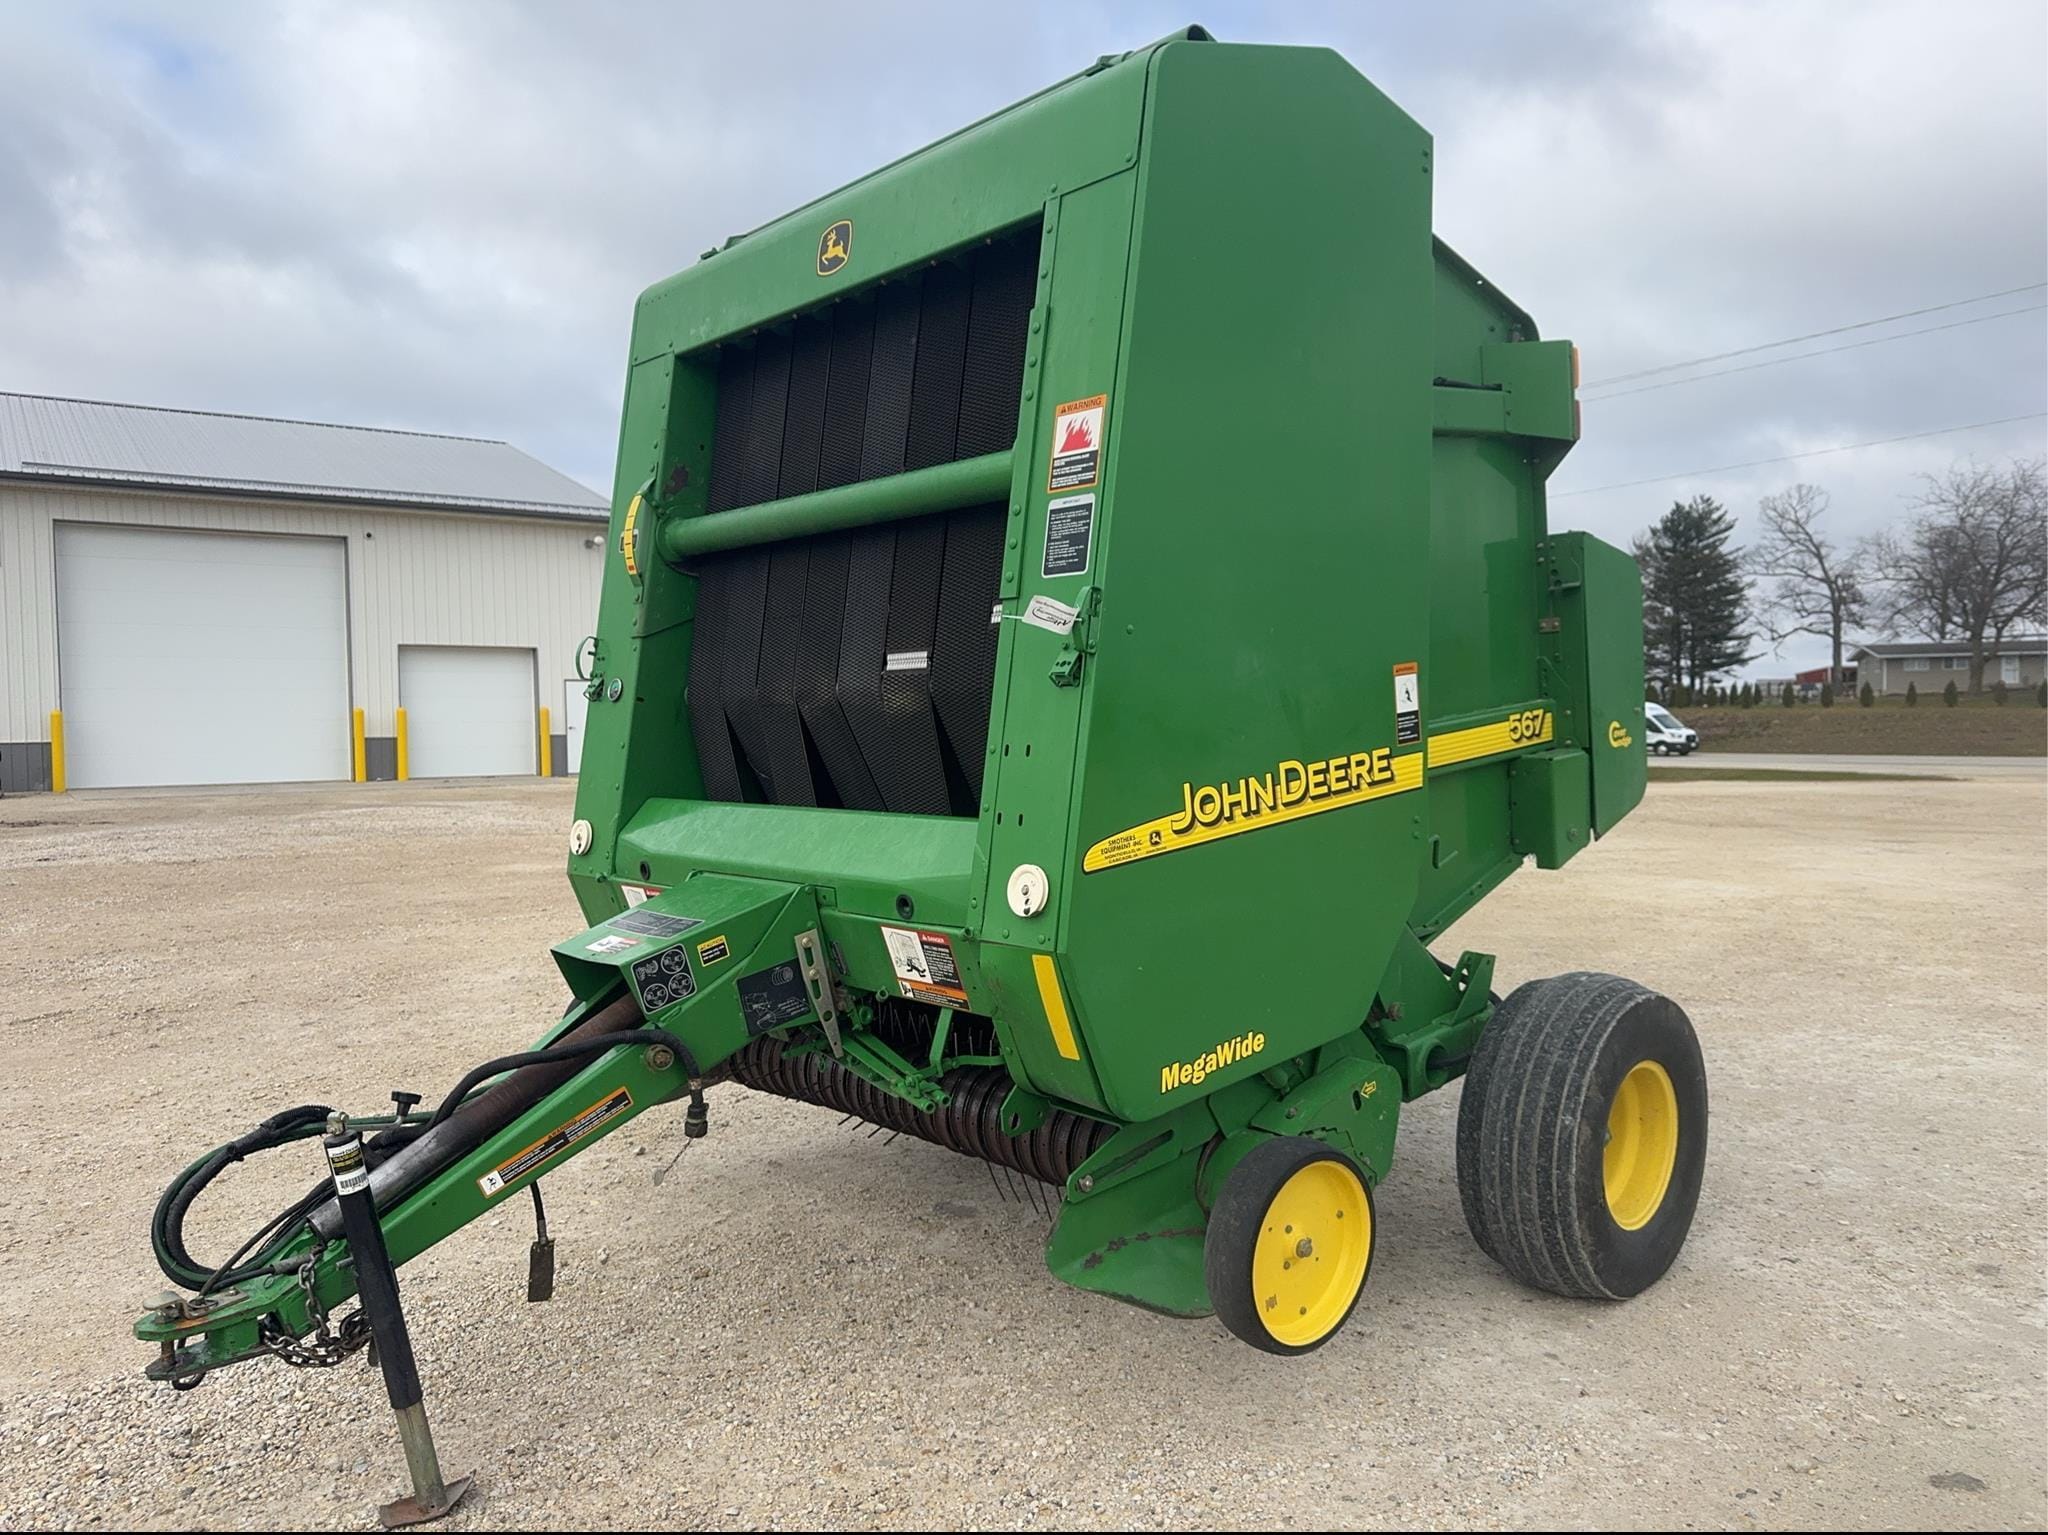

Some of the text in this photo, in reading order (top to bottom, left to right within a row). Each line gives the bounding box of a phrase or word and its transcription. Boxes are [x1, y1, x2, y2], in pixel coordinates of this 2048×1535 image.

[1066, 397, 1102, 411] WARNING
[1508, 708, 1545, 741] 567
[1171, 747, 1394, 833] JOHN DEERE
[1100, 844, 1131, 855] EQUIPMENT
[1108, 834, 1136, 847] SMOTHERS
[1160, 1030, 1266, 1095] MegaWide
